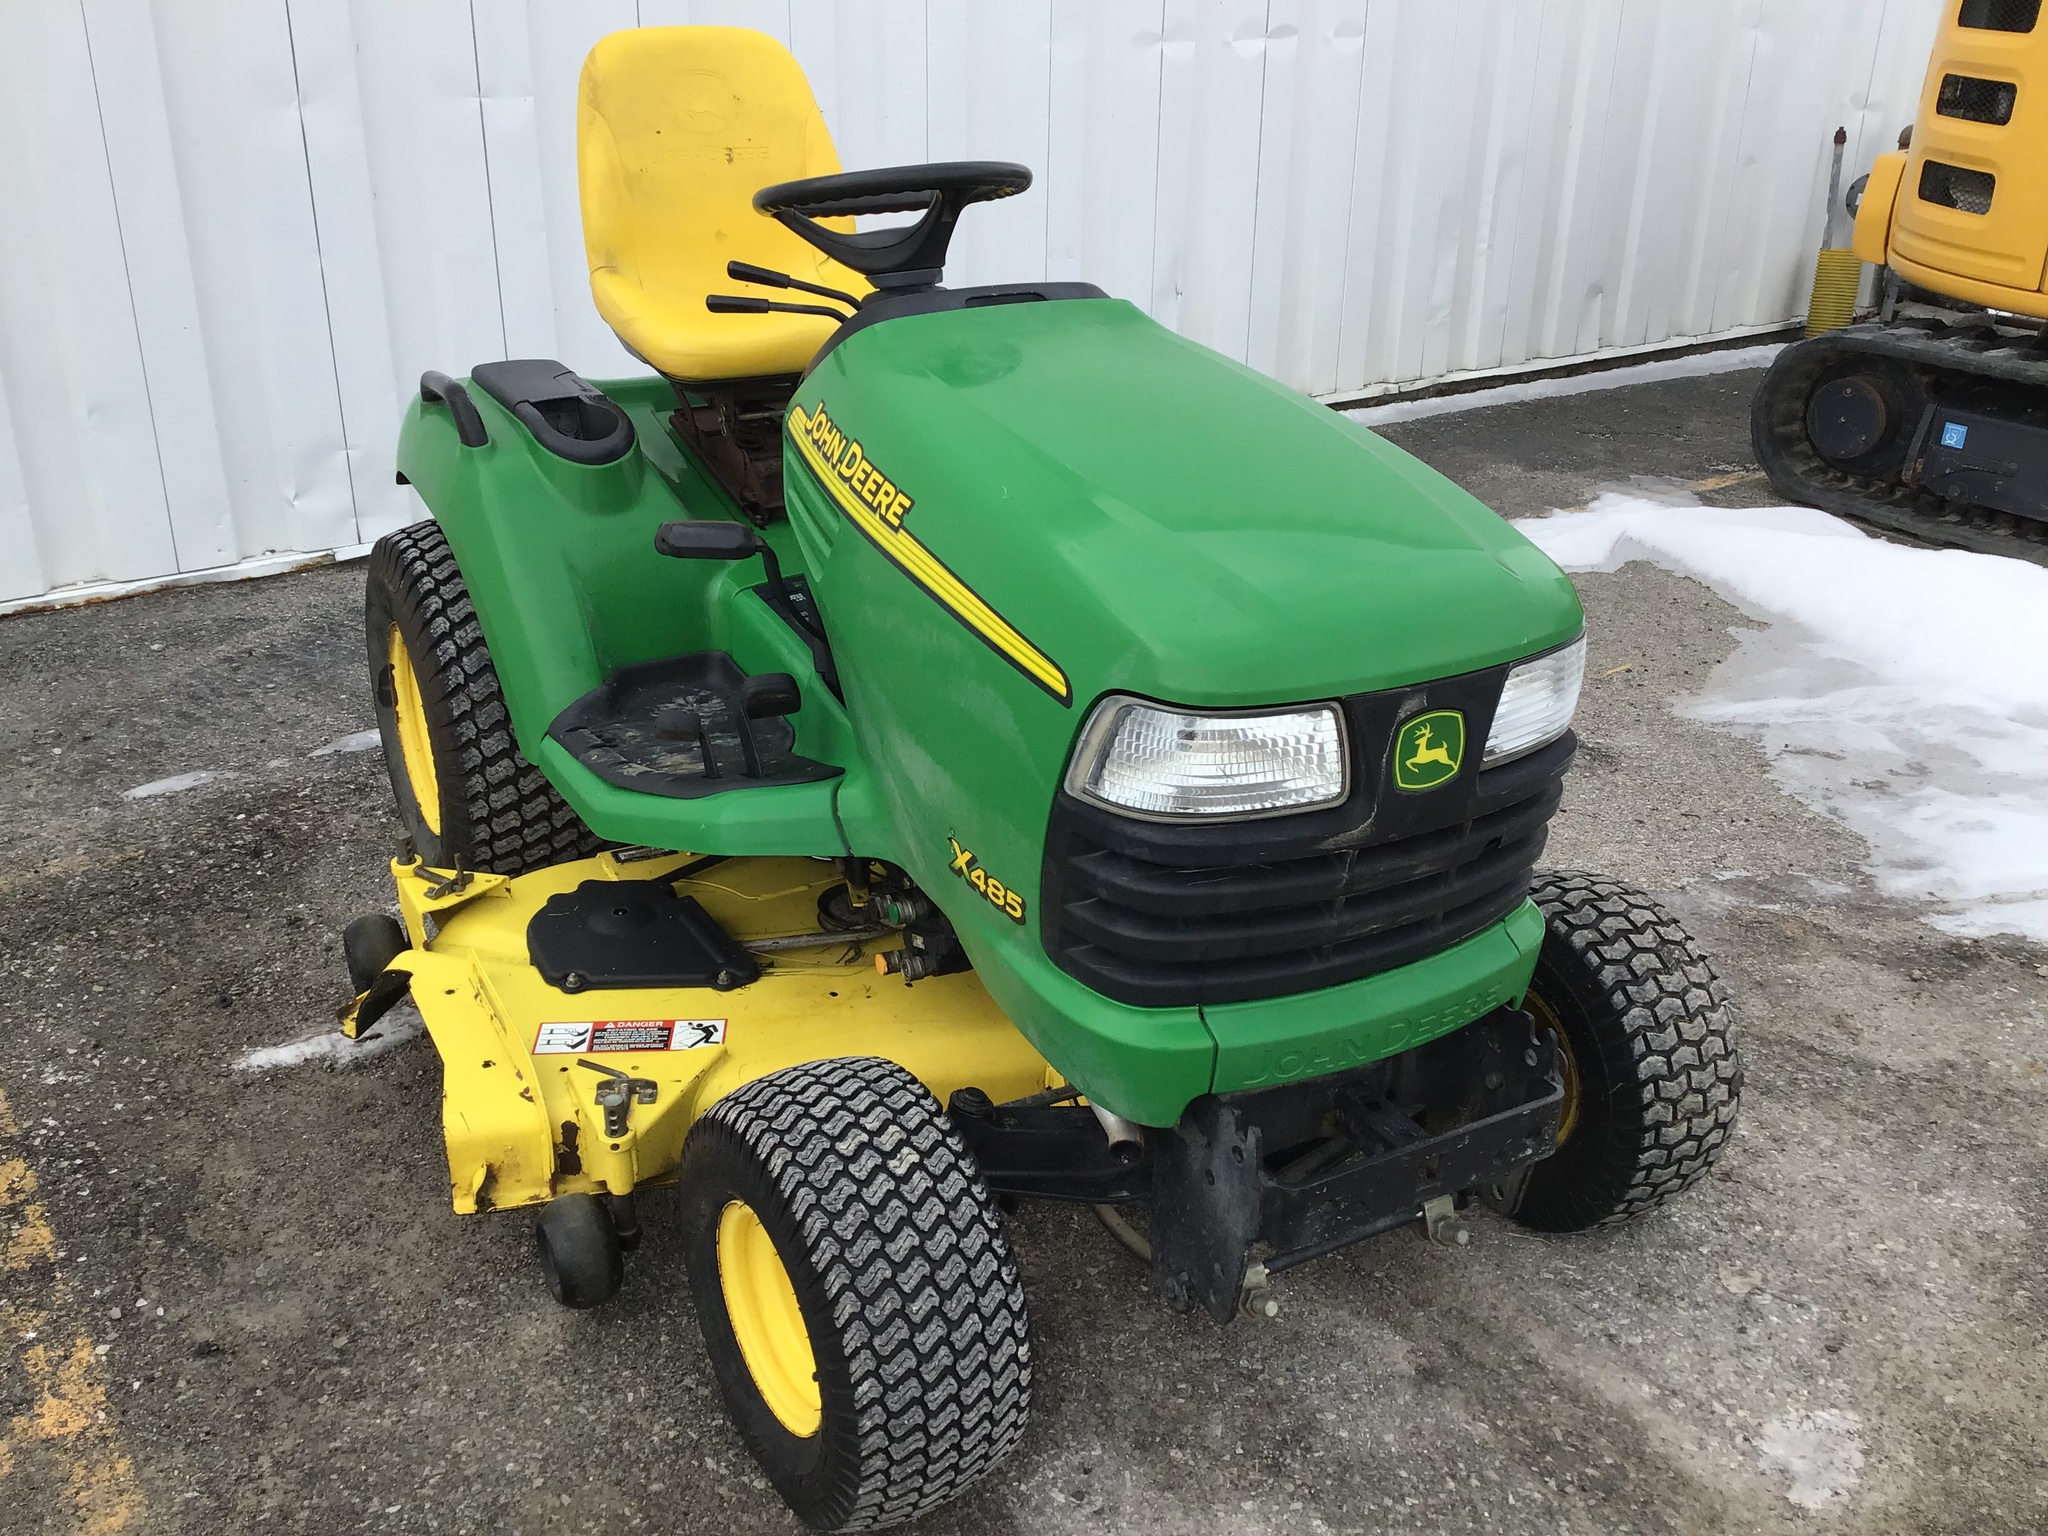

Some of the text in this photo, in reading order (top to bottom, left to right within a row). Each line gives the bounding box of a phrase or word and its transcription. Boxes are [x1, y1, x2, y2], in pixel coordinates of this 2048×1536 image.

[805, 400, 913, 530] JOHN DEERE
[948, 837, 1025, 922] X485
[1243, 985, 1502, 1085] JOHN DEERE
